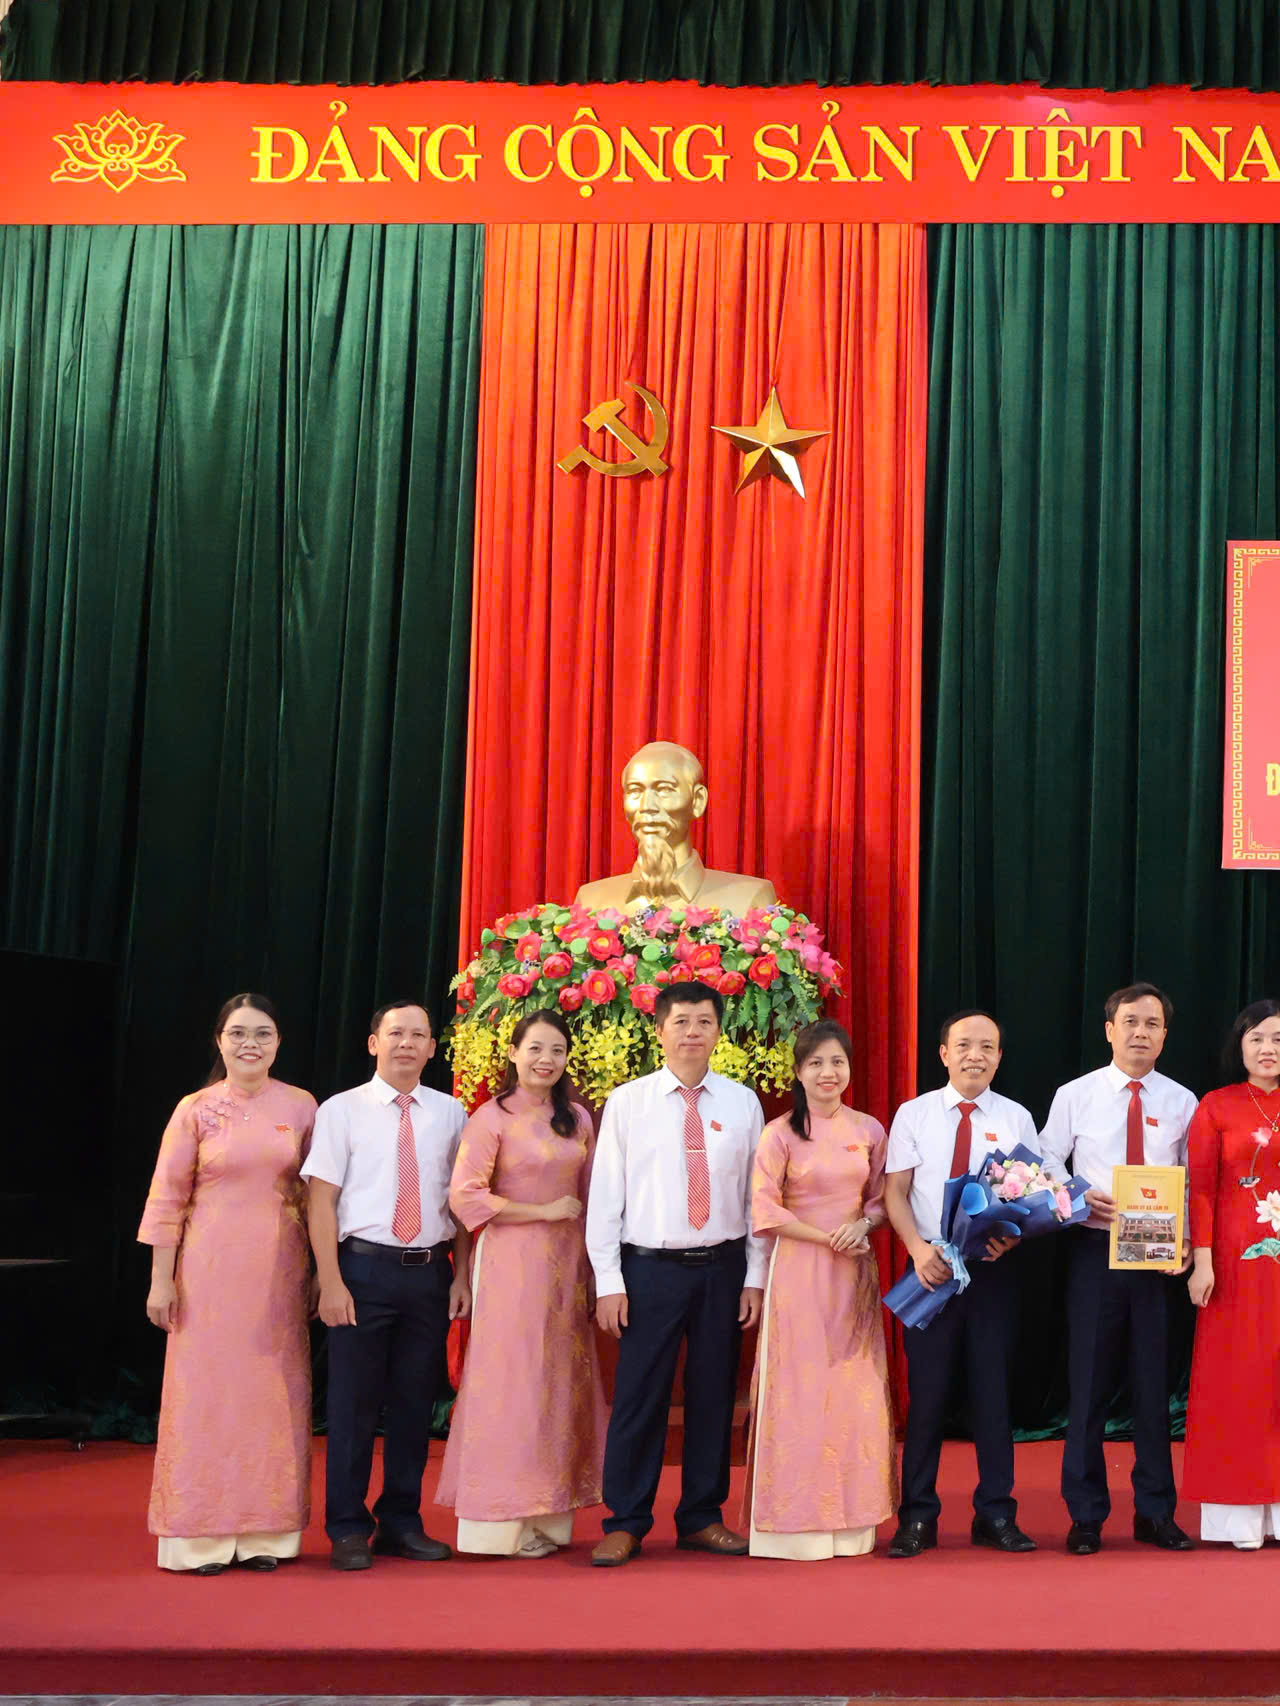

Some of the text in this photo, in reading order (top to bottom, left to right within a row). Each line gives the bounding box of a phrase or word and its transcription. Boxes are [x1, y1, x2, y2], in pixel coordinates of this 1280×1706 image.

[249, 100, 482, 184] ĐẢNG
[503, 107, 731, 198] CỘNG
[753, 100, 921, 182] SẢN
[941, 107, 1142, 198] VIỆT
